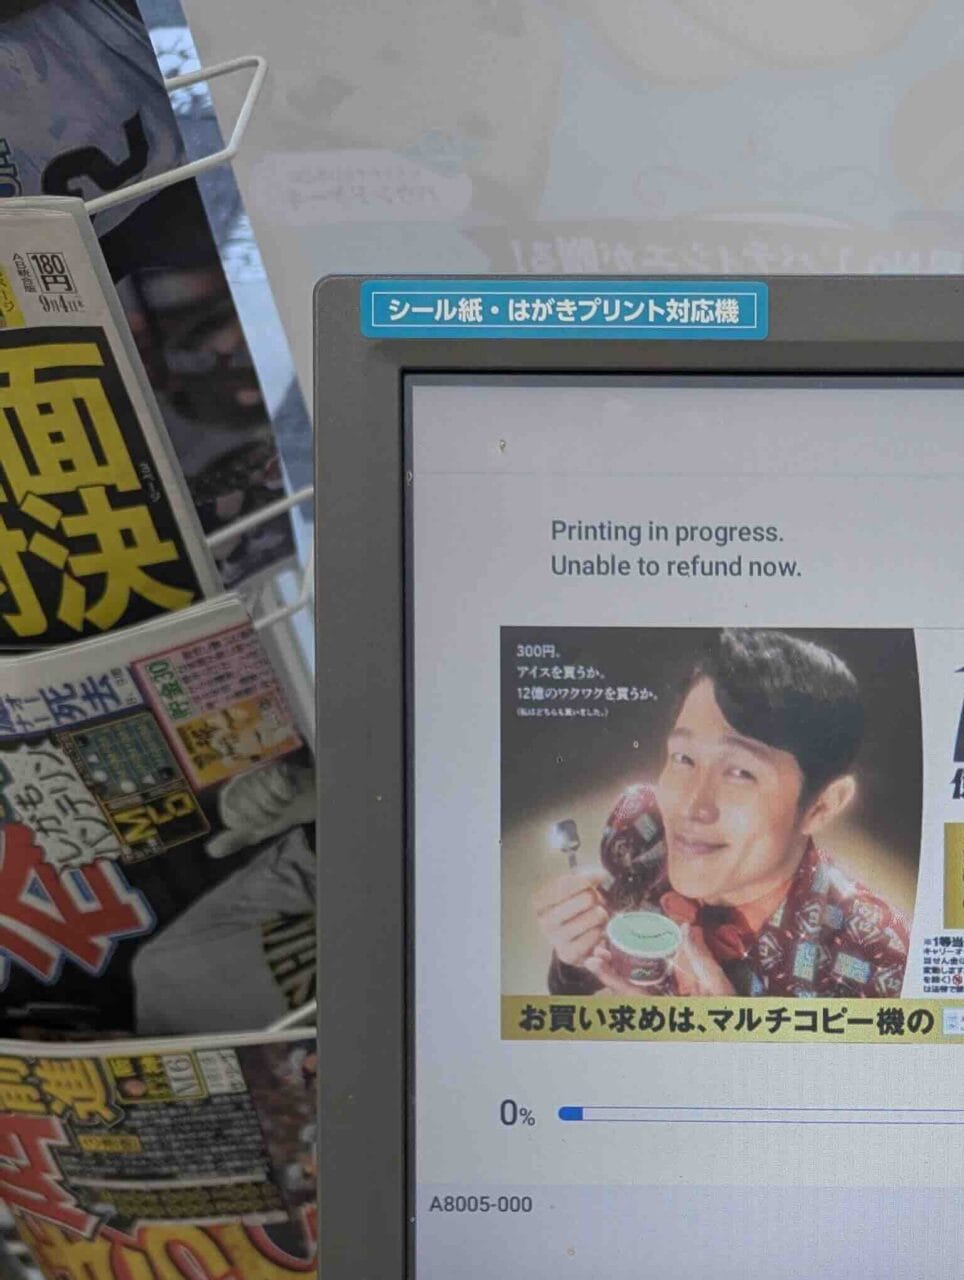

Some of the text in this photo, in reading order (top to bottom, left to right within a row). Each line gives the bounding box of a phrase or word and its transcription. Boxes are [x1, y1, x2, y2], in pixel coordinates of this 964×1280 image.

[30, 253, 65, 275] 180
[388, 297, 741, 325] シール紙・はがきプリント対応機
[551, 519, 784, 547] Printing in progress.
[551, 555, 803, 577] Unable to refund now.
[516, 643, 562, 659] 300円。
[516, 665, 606, 679] アイスを買うか。
[516, 686, 659, 701] 12億のワクワクを買うか。
[519, 1005, 935, 1036] お買い求めは、マルチコピー機の
[499, 1099, 536, 1128] 0%
[429, 1196, 533, 1213] A8005-000
